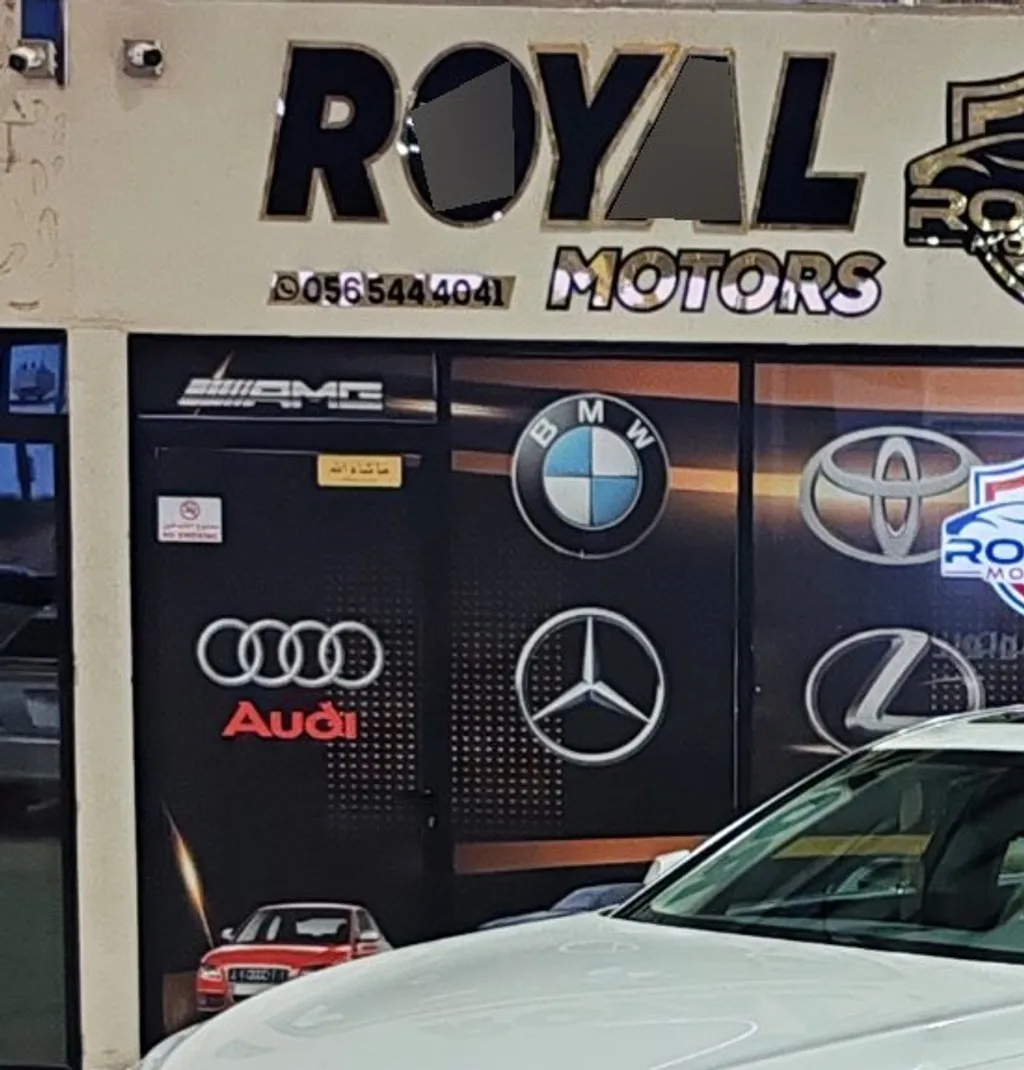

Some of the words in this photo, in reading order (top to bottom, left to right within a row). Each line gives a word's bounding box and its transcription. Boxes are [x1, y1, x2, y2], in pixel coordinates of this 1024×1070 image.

[259, 40, 866, 234] ROYL
[302, 276, 363, 304] 056
[367, 277, 425, 305] 544
[546, 246, 886, 317] MOTORS
[248, 378, 384, 411] AMG
[529, 399, 656, 450] BMW
[221, 700, 357, 740] Audi
